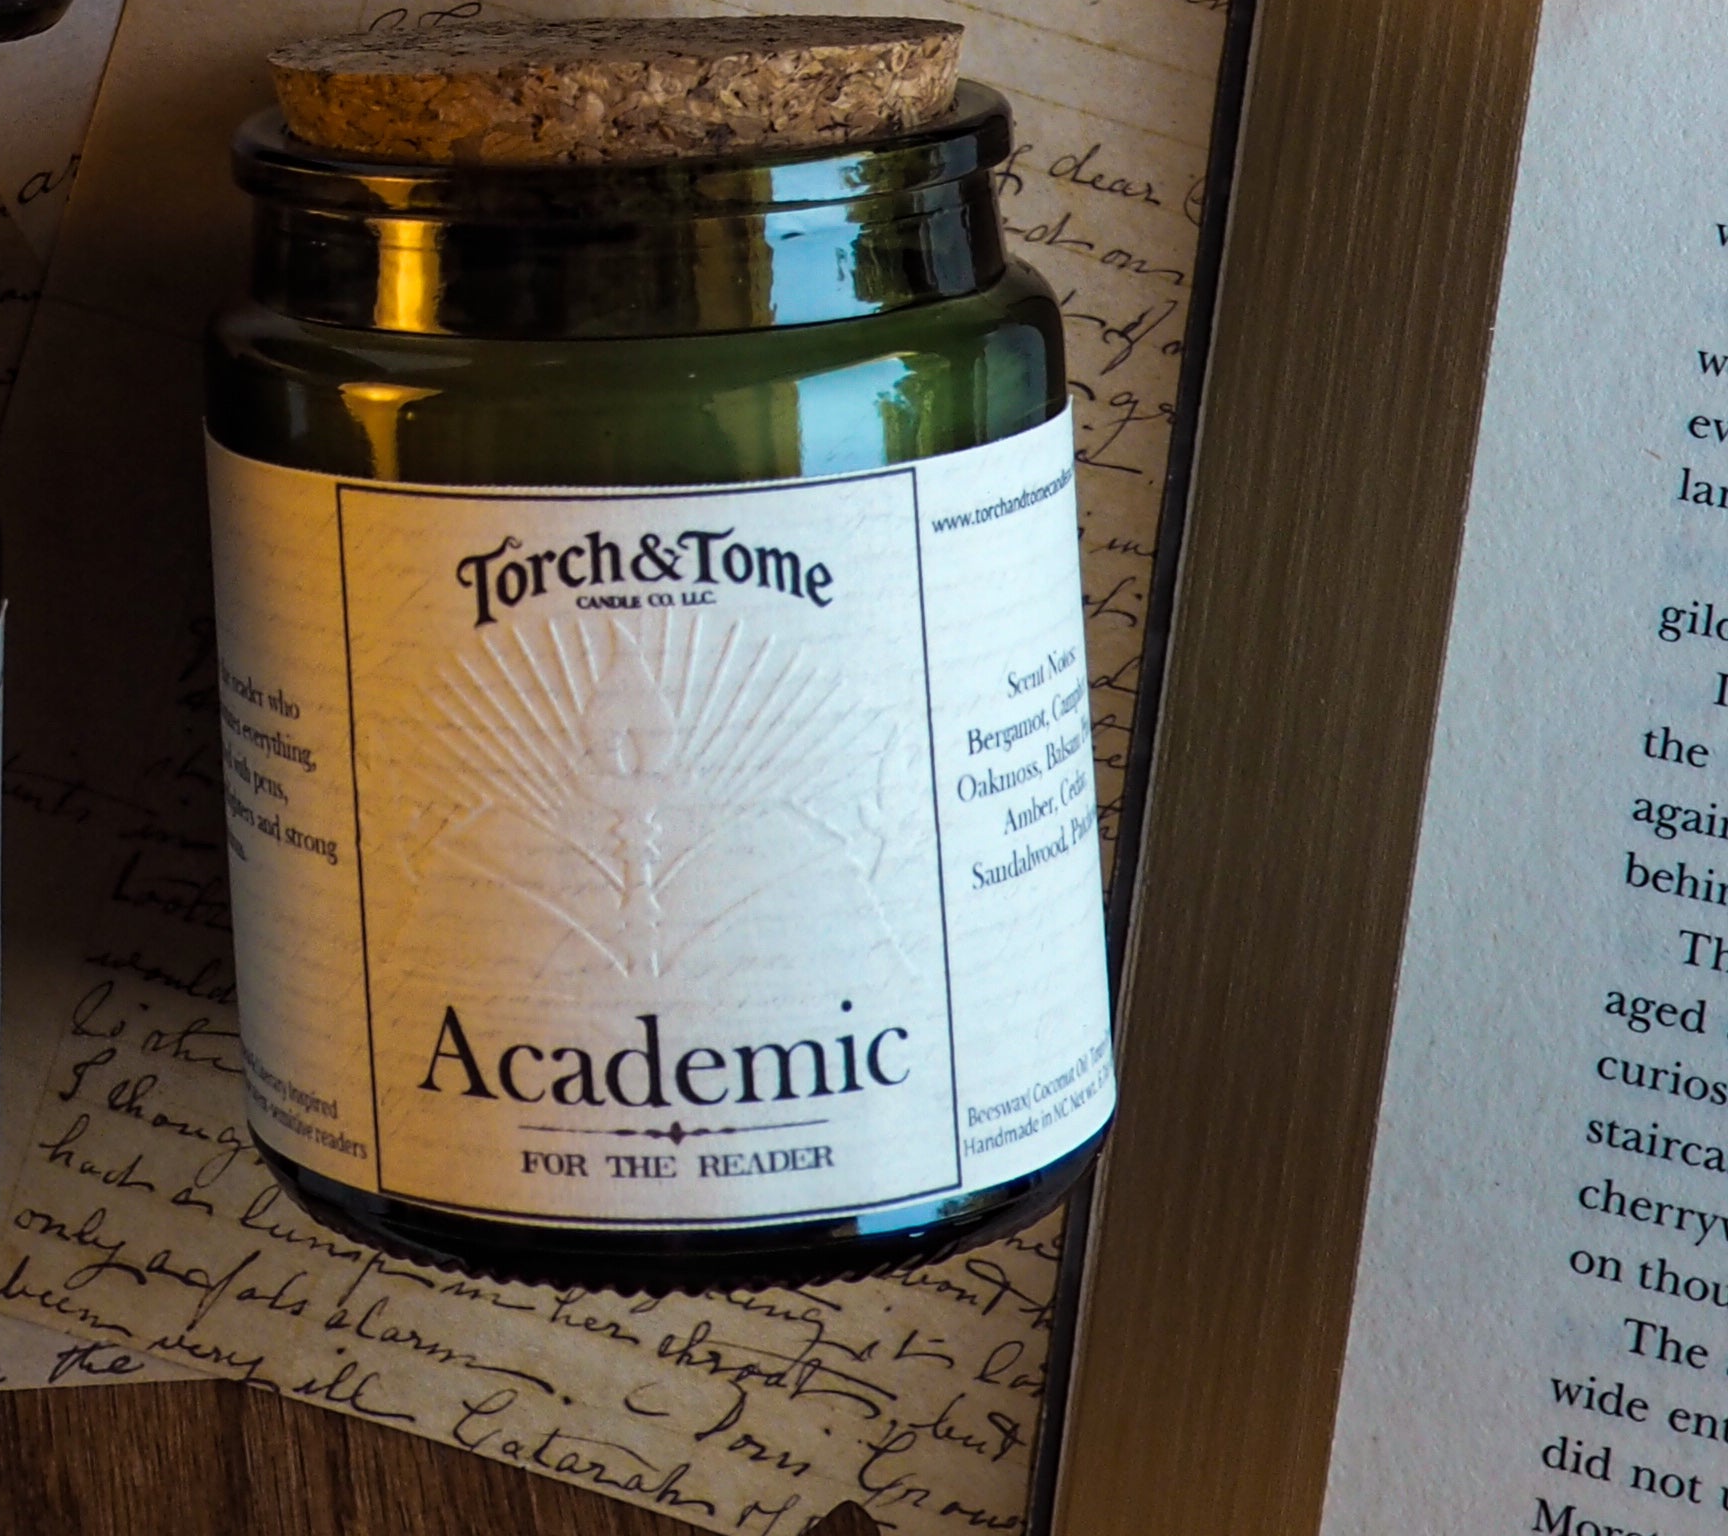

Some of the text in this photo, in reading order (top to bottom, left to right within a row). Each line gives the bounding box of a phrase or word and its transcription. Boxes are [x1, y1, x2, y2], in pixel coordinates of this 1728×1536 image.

[576, 593, 641, 610] CANDLE
[648, 591, 674, 608] CO.
[1007, 665, 1045, 699] Scent
[268, 689, 300, 720] who
[242, 724, 317, 773] everything,
[967, 708, 1051, 757] Bergamot,
[1643, 726, 1710, 769] the
[253, 769, 289, 806] pens,
[957, 760, 1043, 804] Oakmoss,
[1003, 795, 1058, 836] Amber,
[257, 814, 281, 843] and
[285, 826, 339, 866] strong
[972, 829, 1069, 892] Sandalwood,
[1605, 990, 1708, 1034] aged
[417, 999, 911, 1109] Academic
[1033, 1067, 1075, 1104] Coconut
[314, 1128, 368, 1160] readers
[963, 1116, 1040, 1159] Handmade
[1041, 1110, 1053, 1129] in
[1053, 1097, 1070, 1124] NC
[1585, 1117, 1728, 1173] stairca
[521, 1145, 835, 1179] FOR THE READER
[1569, 1248, 1623, 1284] on
[1624, 1317, 1710, 1370] The
[1550, 1376, 1650, 1423] wide
[1541, 1435, 1703, 1504] did not
